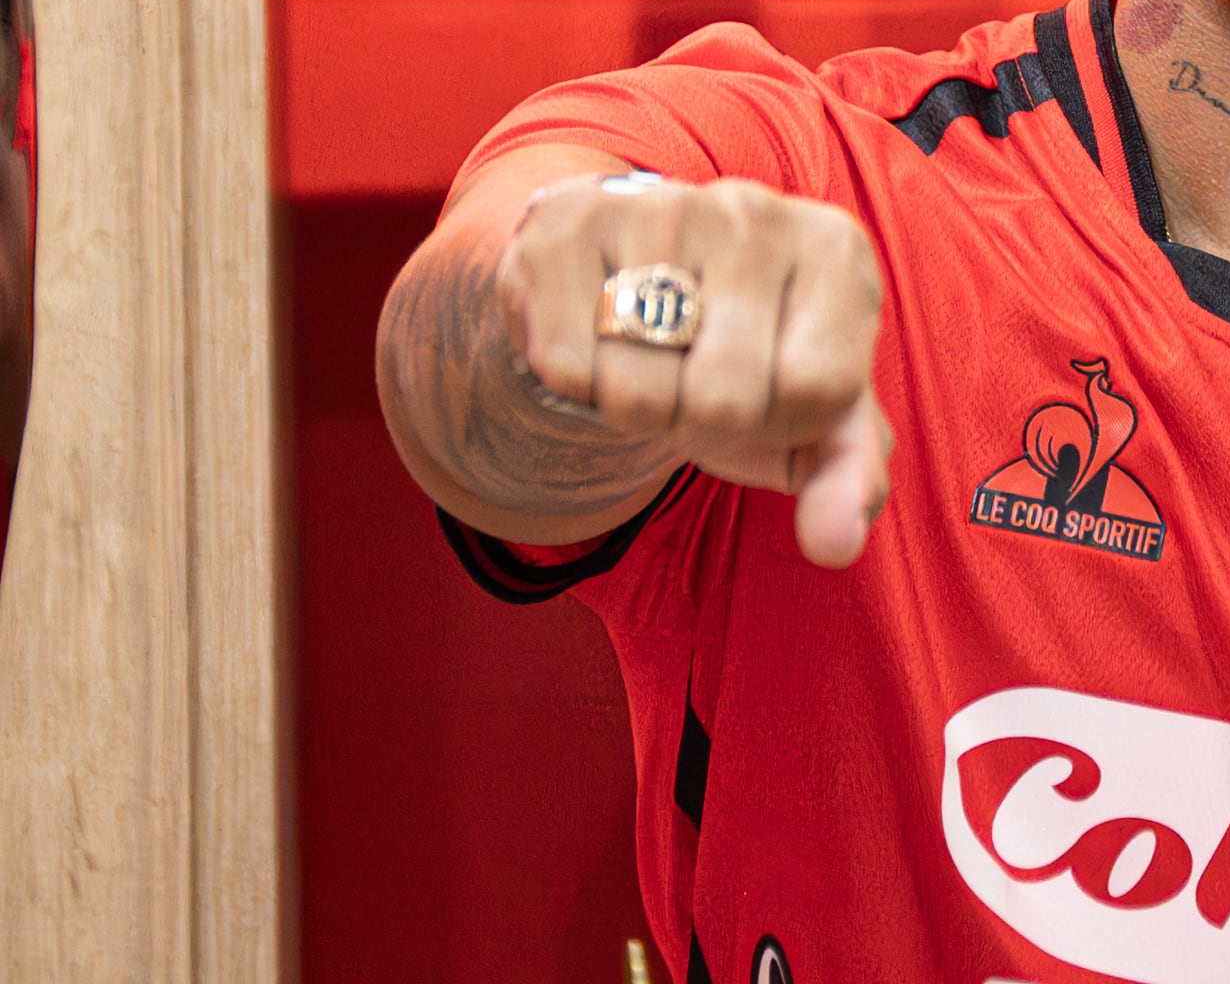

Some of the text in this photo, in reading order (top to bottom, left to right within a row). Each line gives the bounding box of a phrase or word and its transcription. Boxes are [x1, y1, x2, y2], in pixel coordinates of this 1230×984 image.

[975, 492, 1162, 555] LE COQ SPORTIF
